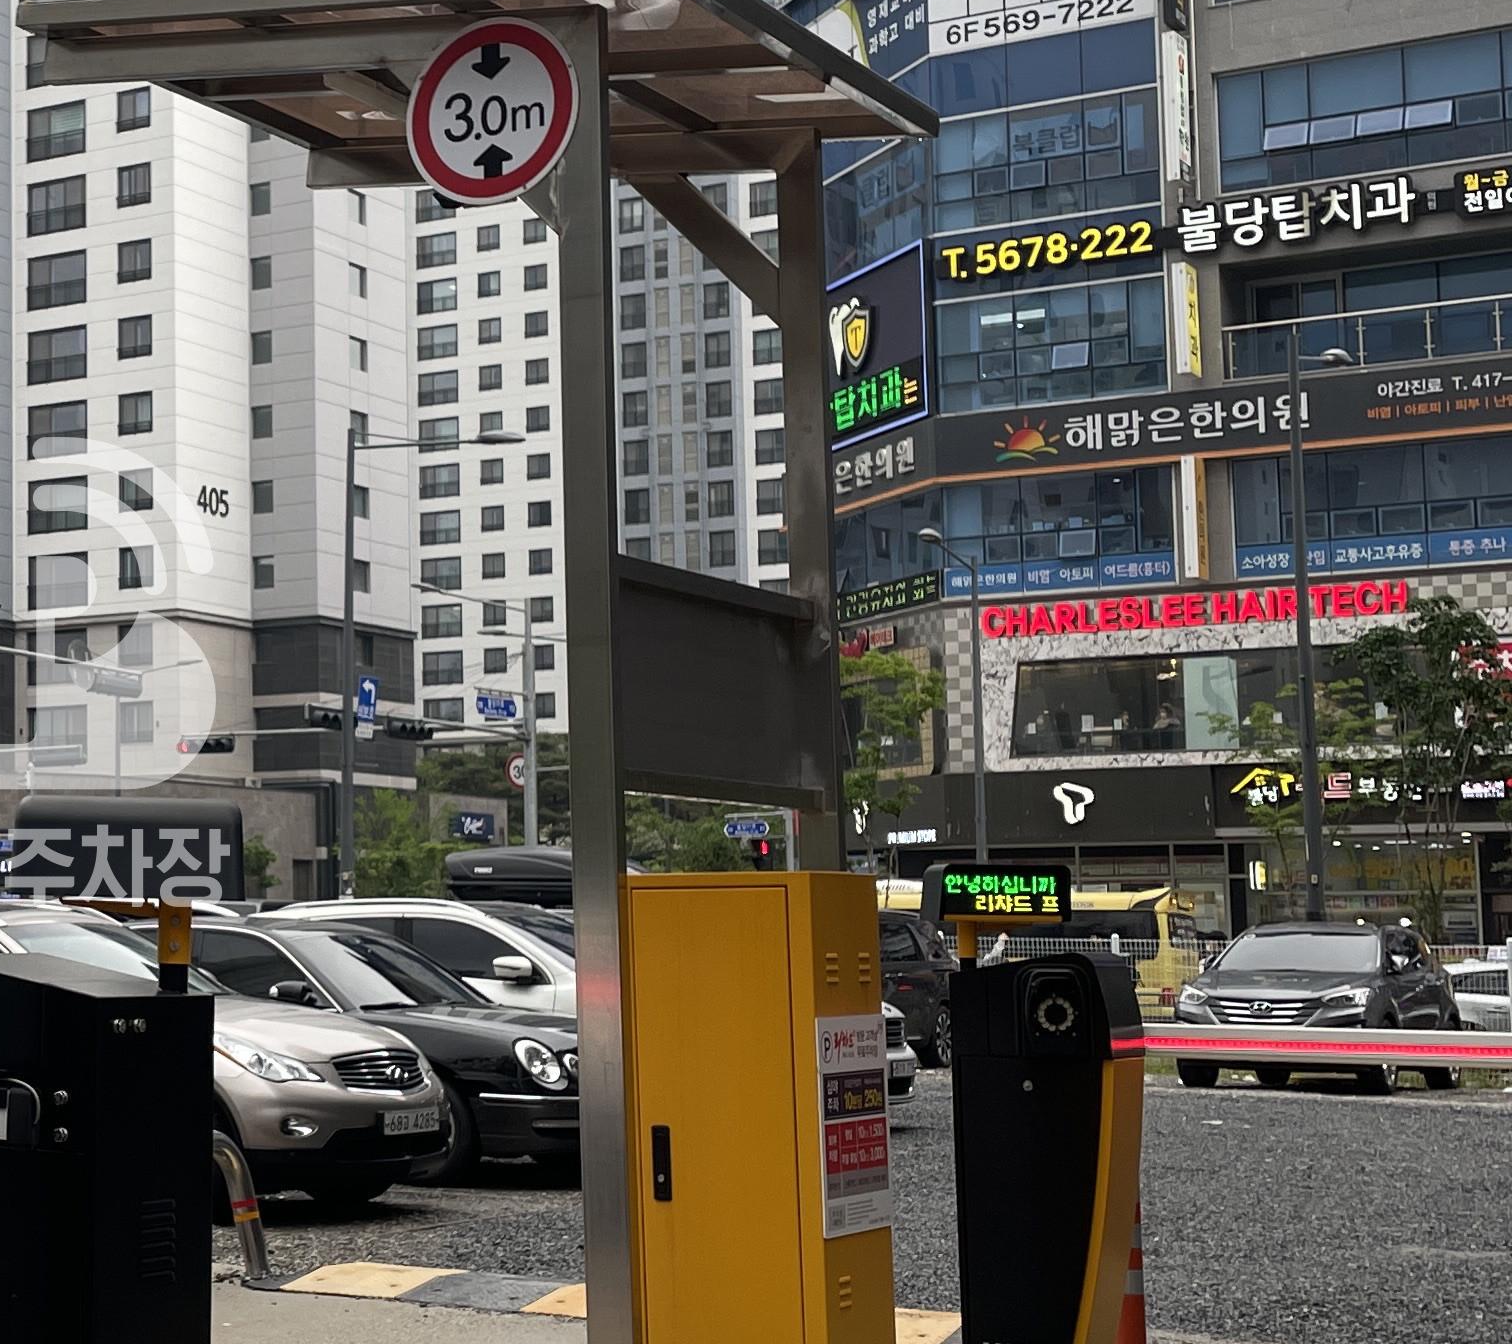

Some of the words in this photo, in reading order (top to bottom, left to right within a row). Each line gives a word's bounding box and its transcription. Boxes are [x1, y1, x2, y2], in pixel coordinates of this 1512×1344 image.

[444, 92, 545, 142] 3.0m
[1177, 177, 1416, 253] 불당탑치과
[1377, 378, 1443, 398] 야간진료
[1064, 391, 1310, 452] 해맑은한의원
[197, 485, 229, 518] 405
[1335, 543, 1424, 563] 교통사고후유증
[1059, 567, 1094, 583] 아토피
[982, 593, 1206, 639] CHARLESLEE
[1211, 586, 1297, 624] HAIR
[1309, 579, 1407, 618] TECH
[945, 874, 1057, 894] 안녕하십니까
[1041, 895, 1060, 912] 프
